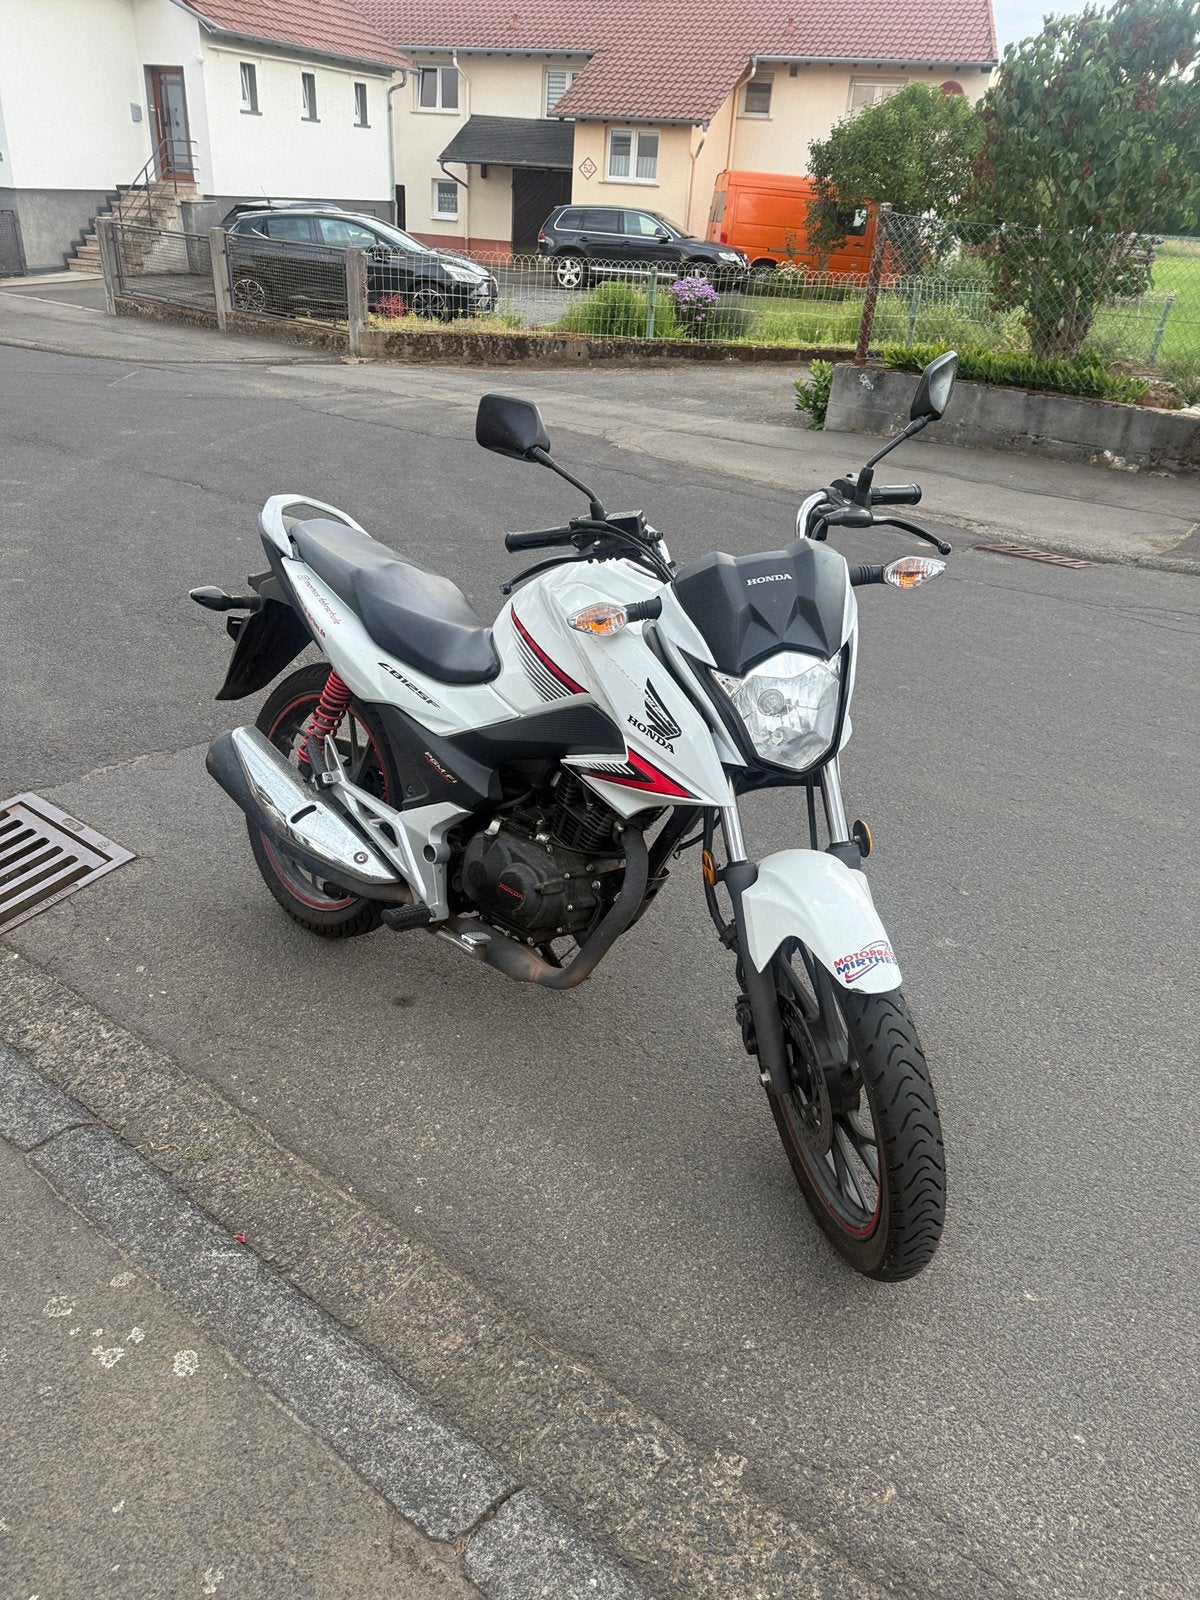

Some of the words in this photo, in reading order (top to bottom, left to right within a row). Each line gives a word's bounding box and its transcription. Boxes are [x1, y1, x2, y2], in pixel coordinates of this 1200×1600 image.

[583, 164, 593, 174] 52
[746, 573, 793, 586] HONDA
[377, 662, 441, 708] CB125F
[627, 714, 675, 754] HONDA
